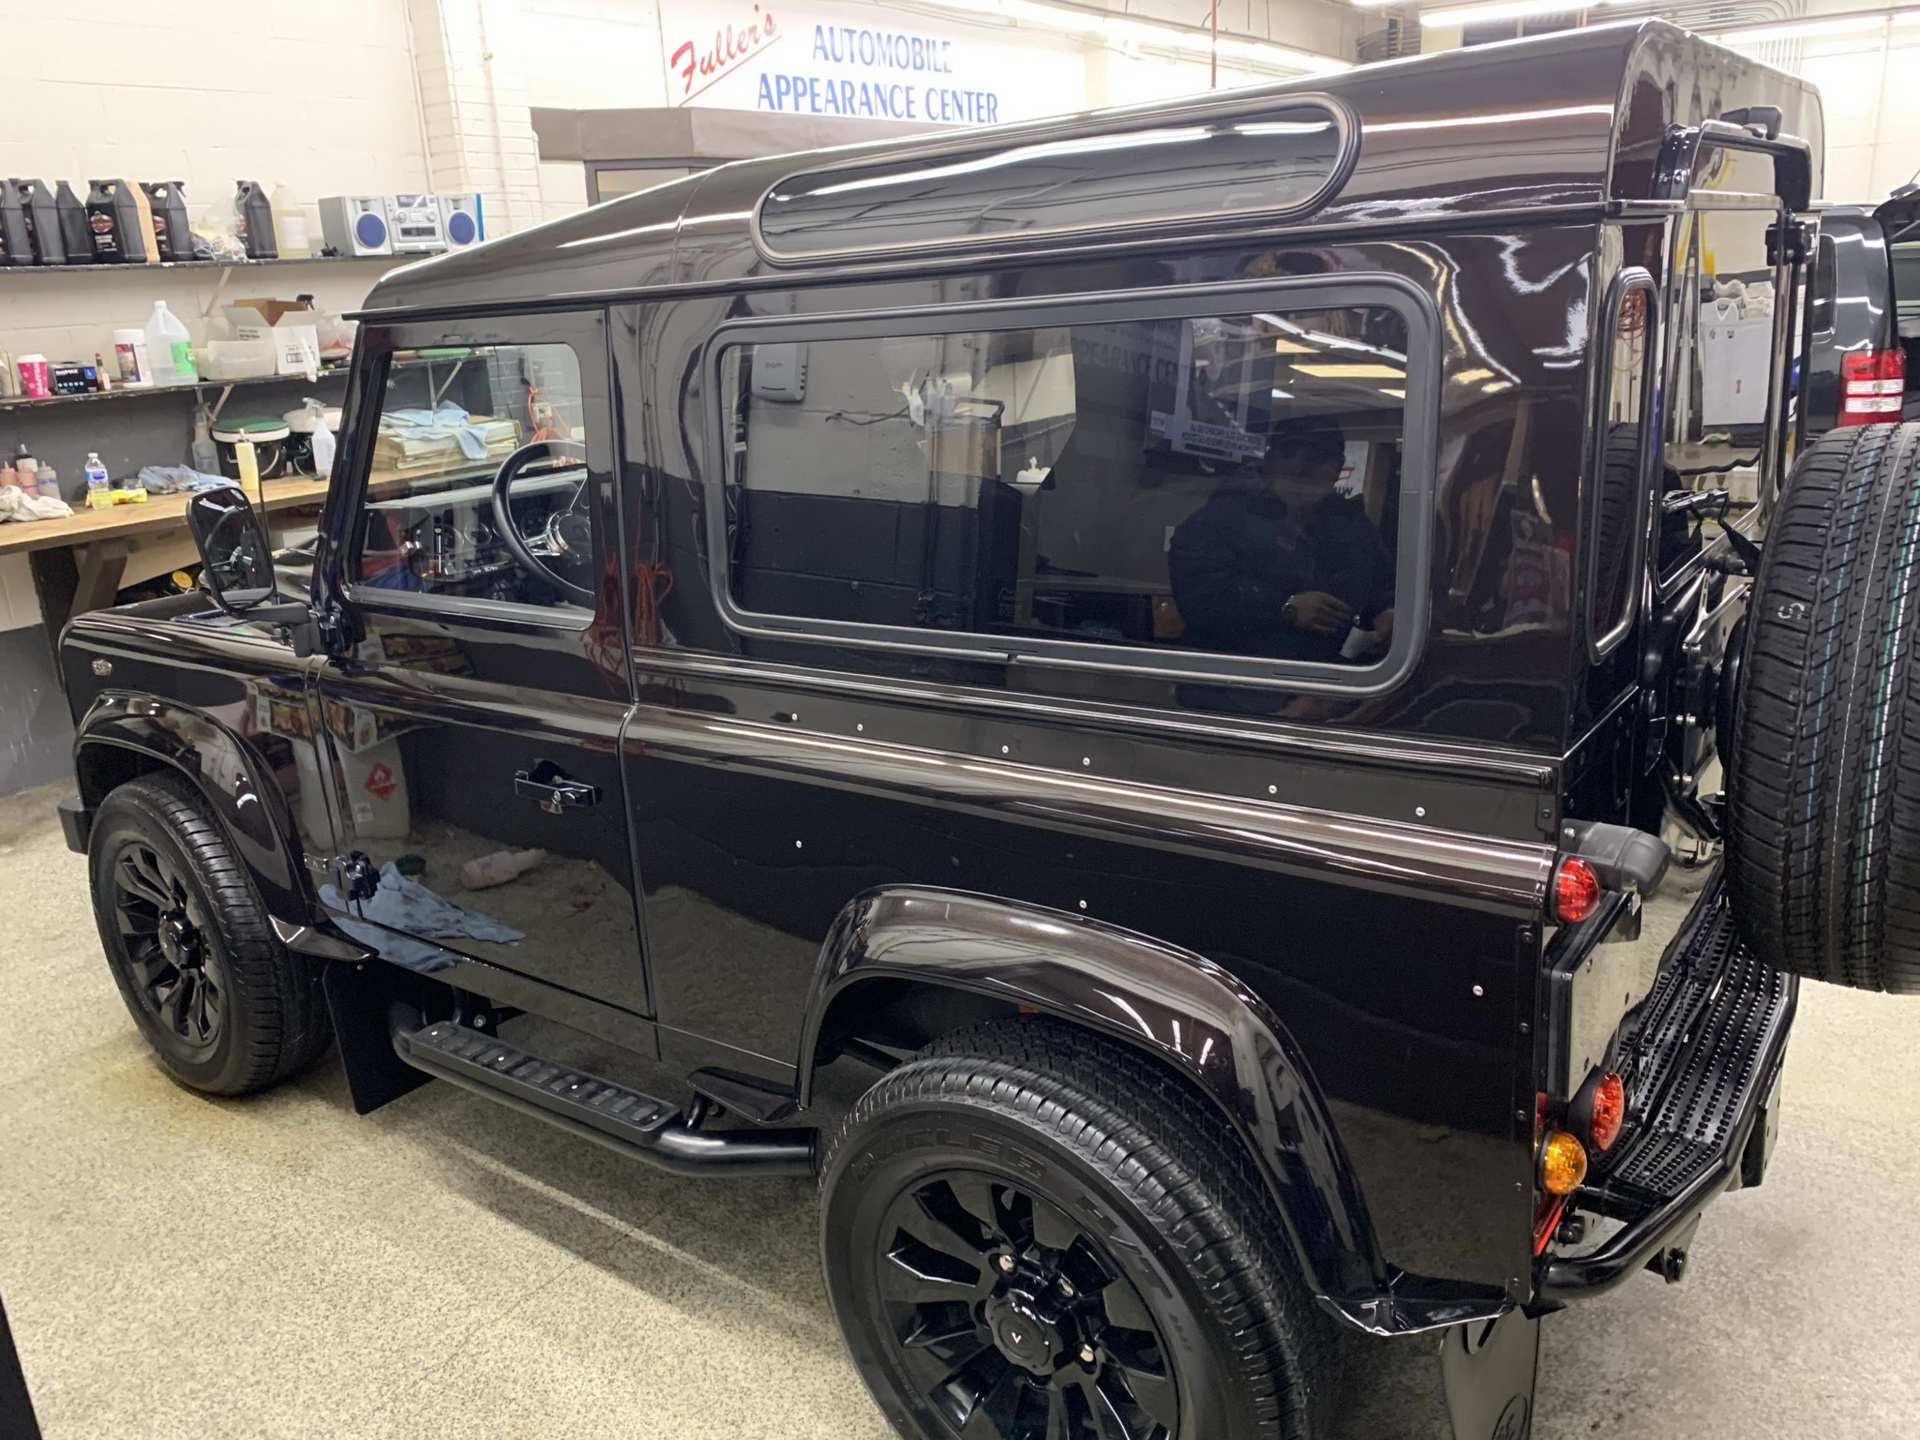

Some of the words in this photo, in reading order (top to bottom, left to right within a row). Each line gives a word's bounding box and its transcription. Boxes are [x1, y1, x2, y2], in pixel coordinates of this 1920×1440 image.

[671, 4, 777, 94] Fuller's
[813, 24, 952, 74] AUTOMOBILE
[757, 73, 916, 121] APPEARANCE
[924, 86, 998, 123] CENTER
